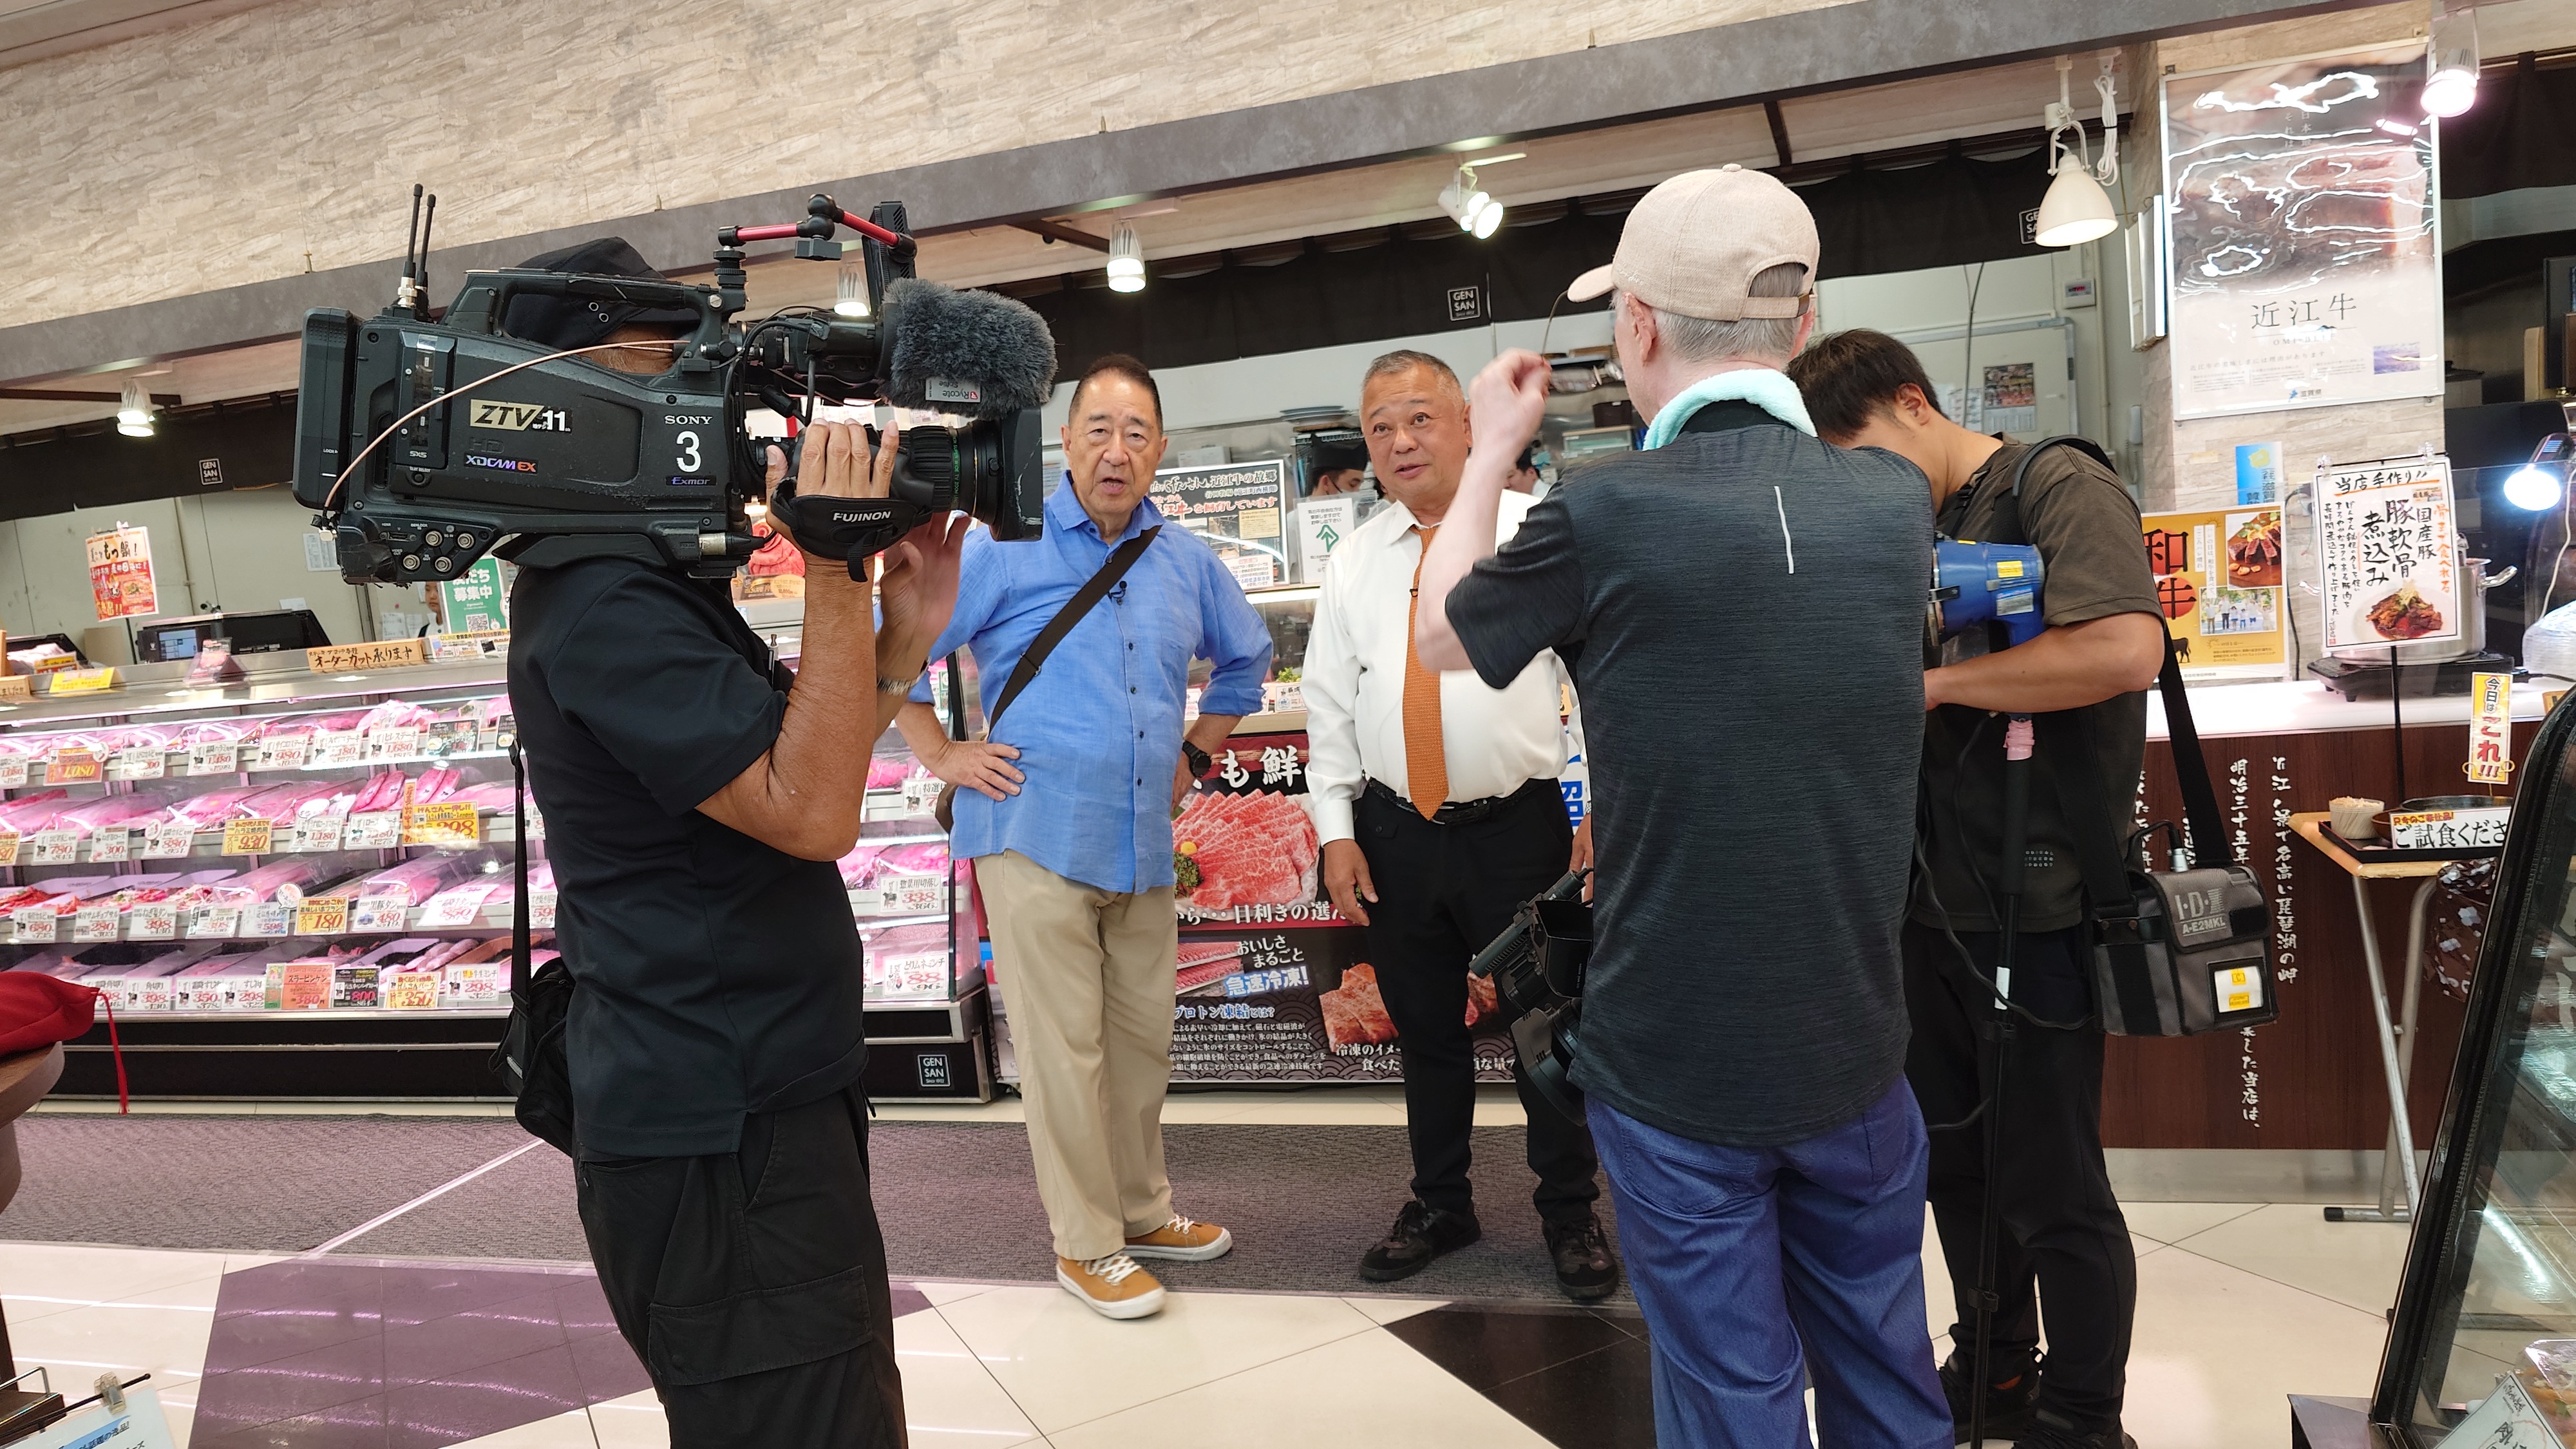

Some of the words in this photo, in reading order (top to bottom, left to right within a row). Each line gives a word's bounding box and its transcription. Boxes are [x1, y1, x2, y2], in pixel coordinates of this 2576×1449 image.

[2025, 213, 2039, 222] GE
[2027, 224, 2038, 233] SA
[1454, 290, 1473, 301] GEN
[1454, 301, 1475, 311] SAN
[2251, 293, 2356, 329] 近江牛
[942, 388, 969, 399] Rycote
[474, 405, 536, 428] ZTV
[664, 415, 712, 425] SONY
[676, 431, 701, 473] 3
[466, 455, 515, 470] XDCAM
[517, 460, 536, 473] EX
[204, 469, 218, 477] SAN
[833, 511, 891, 522] FUJINON
[2384, 498, 2417, 578] 豚軟骨
[2416, 507, 2438, 560] 国産豚
[2362, 510, 2390, 587] 煮込み
[2433, 504, 2454, 594] 骨まで食べれる
[2143, 529, 2197, 620] 和牛
[453, 584, 493, 602] 募集中
[315, 647, 413, 668] オーダーカット承ります
[385, 732, 418, 741] ヒレステーキ
[276, 751, 301, 760] 980
[162, 839, 186, 848] 880
[238, 835, 268, 849] 930
[50, 846, 73, 855] 780
[106, 846, 124, 855] 300
[902, 892, 935, 903] 338
[313, 913, 343, 930] 180
[377, 912, 401, 923] 480
[29, 923, 52, 933] 680
[90, 922, 115, 932] 280
[144, 920, 172, 930] 398
[1236, 935, 1287, 956] おいしさ
[1253, 948, 1305, 968] まるごと
[904, 958, 945, 970] とりムネミンチ
[907, 972, 940, 984] 88
[1226, 966, 1309, 996] 急速冷凍!
[465, 983, 494, 992] 298
[141, 992, 166, 1003] 398
[193, 993, 219, 1003] 350
[239, 992, 264, 1002] 298
[1175, 1003, 1276, 1020] プロトン凍結とは?
[923, 1057, 943, 1066] GEN
[924, 1068, 944, 1078] SAN
